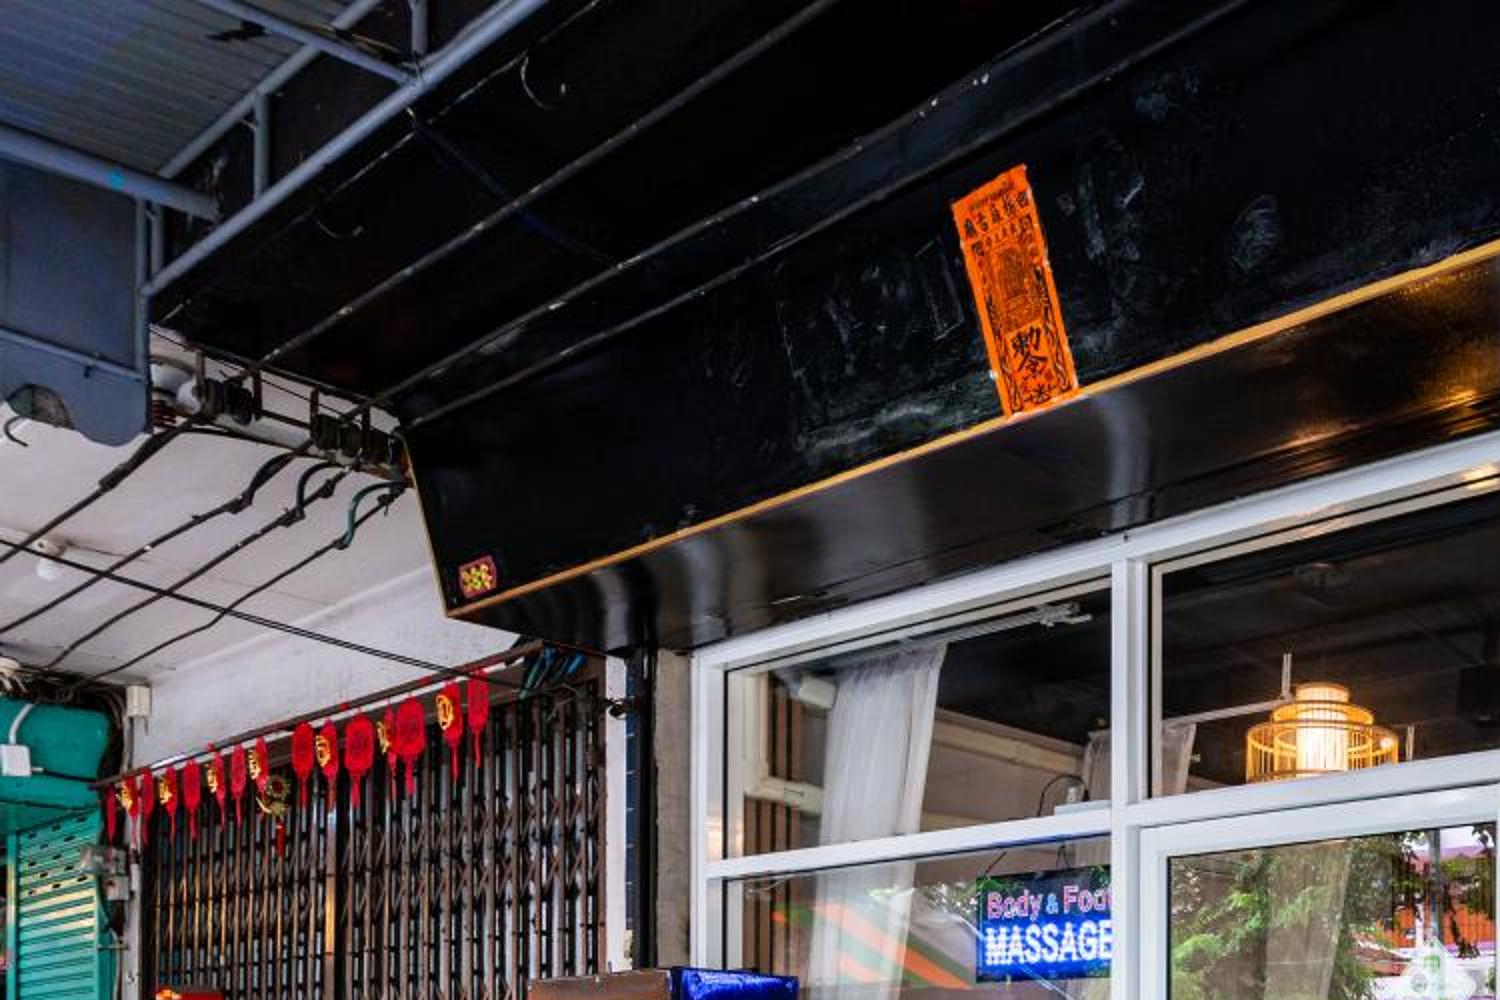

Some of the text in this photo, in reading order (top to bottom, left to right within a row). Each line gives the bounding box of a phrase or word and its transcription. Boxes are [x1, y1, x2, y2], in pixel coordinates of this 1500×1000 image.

[987, 889, 1042, 921] Body
[1045, 893, 1059, 915] &
[985, 919, 1114, 966] MASSAGE
